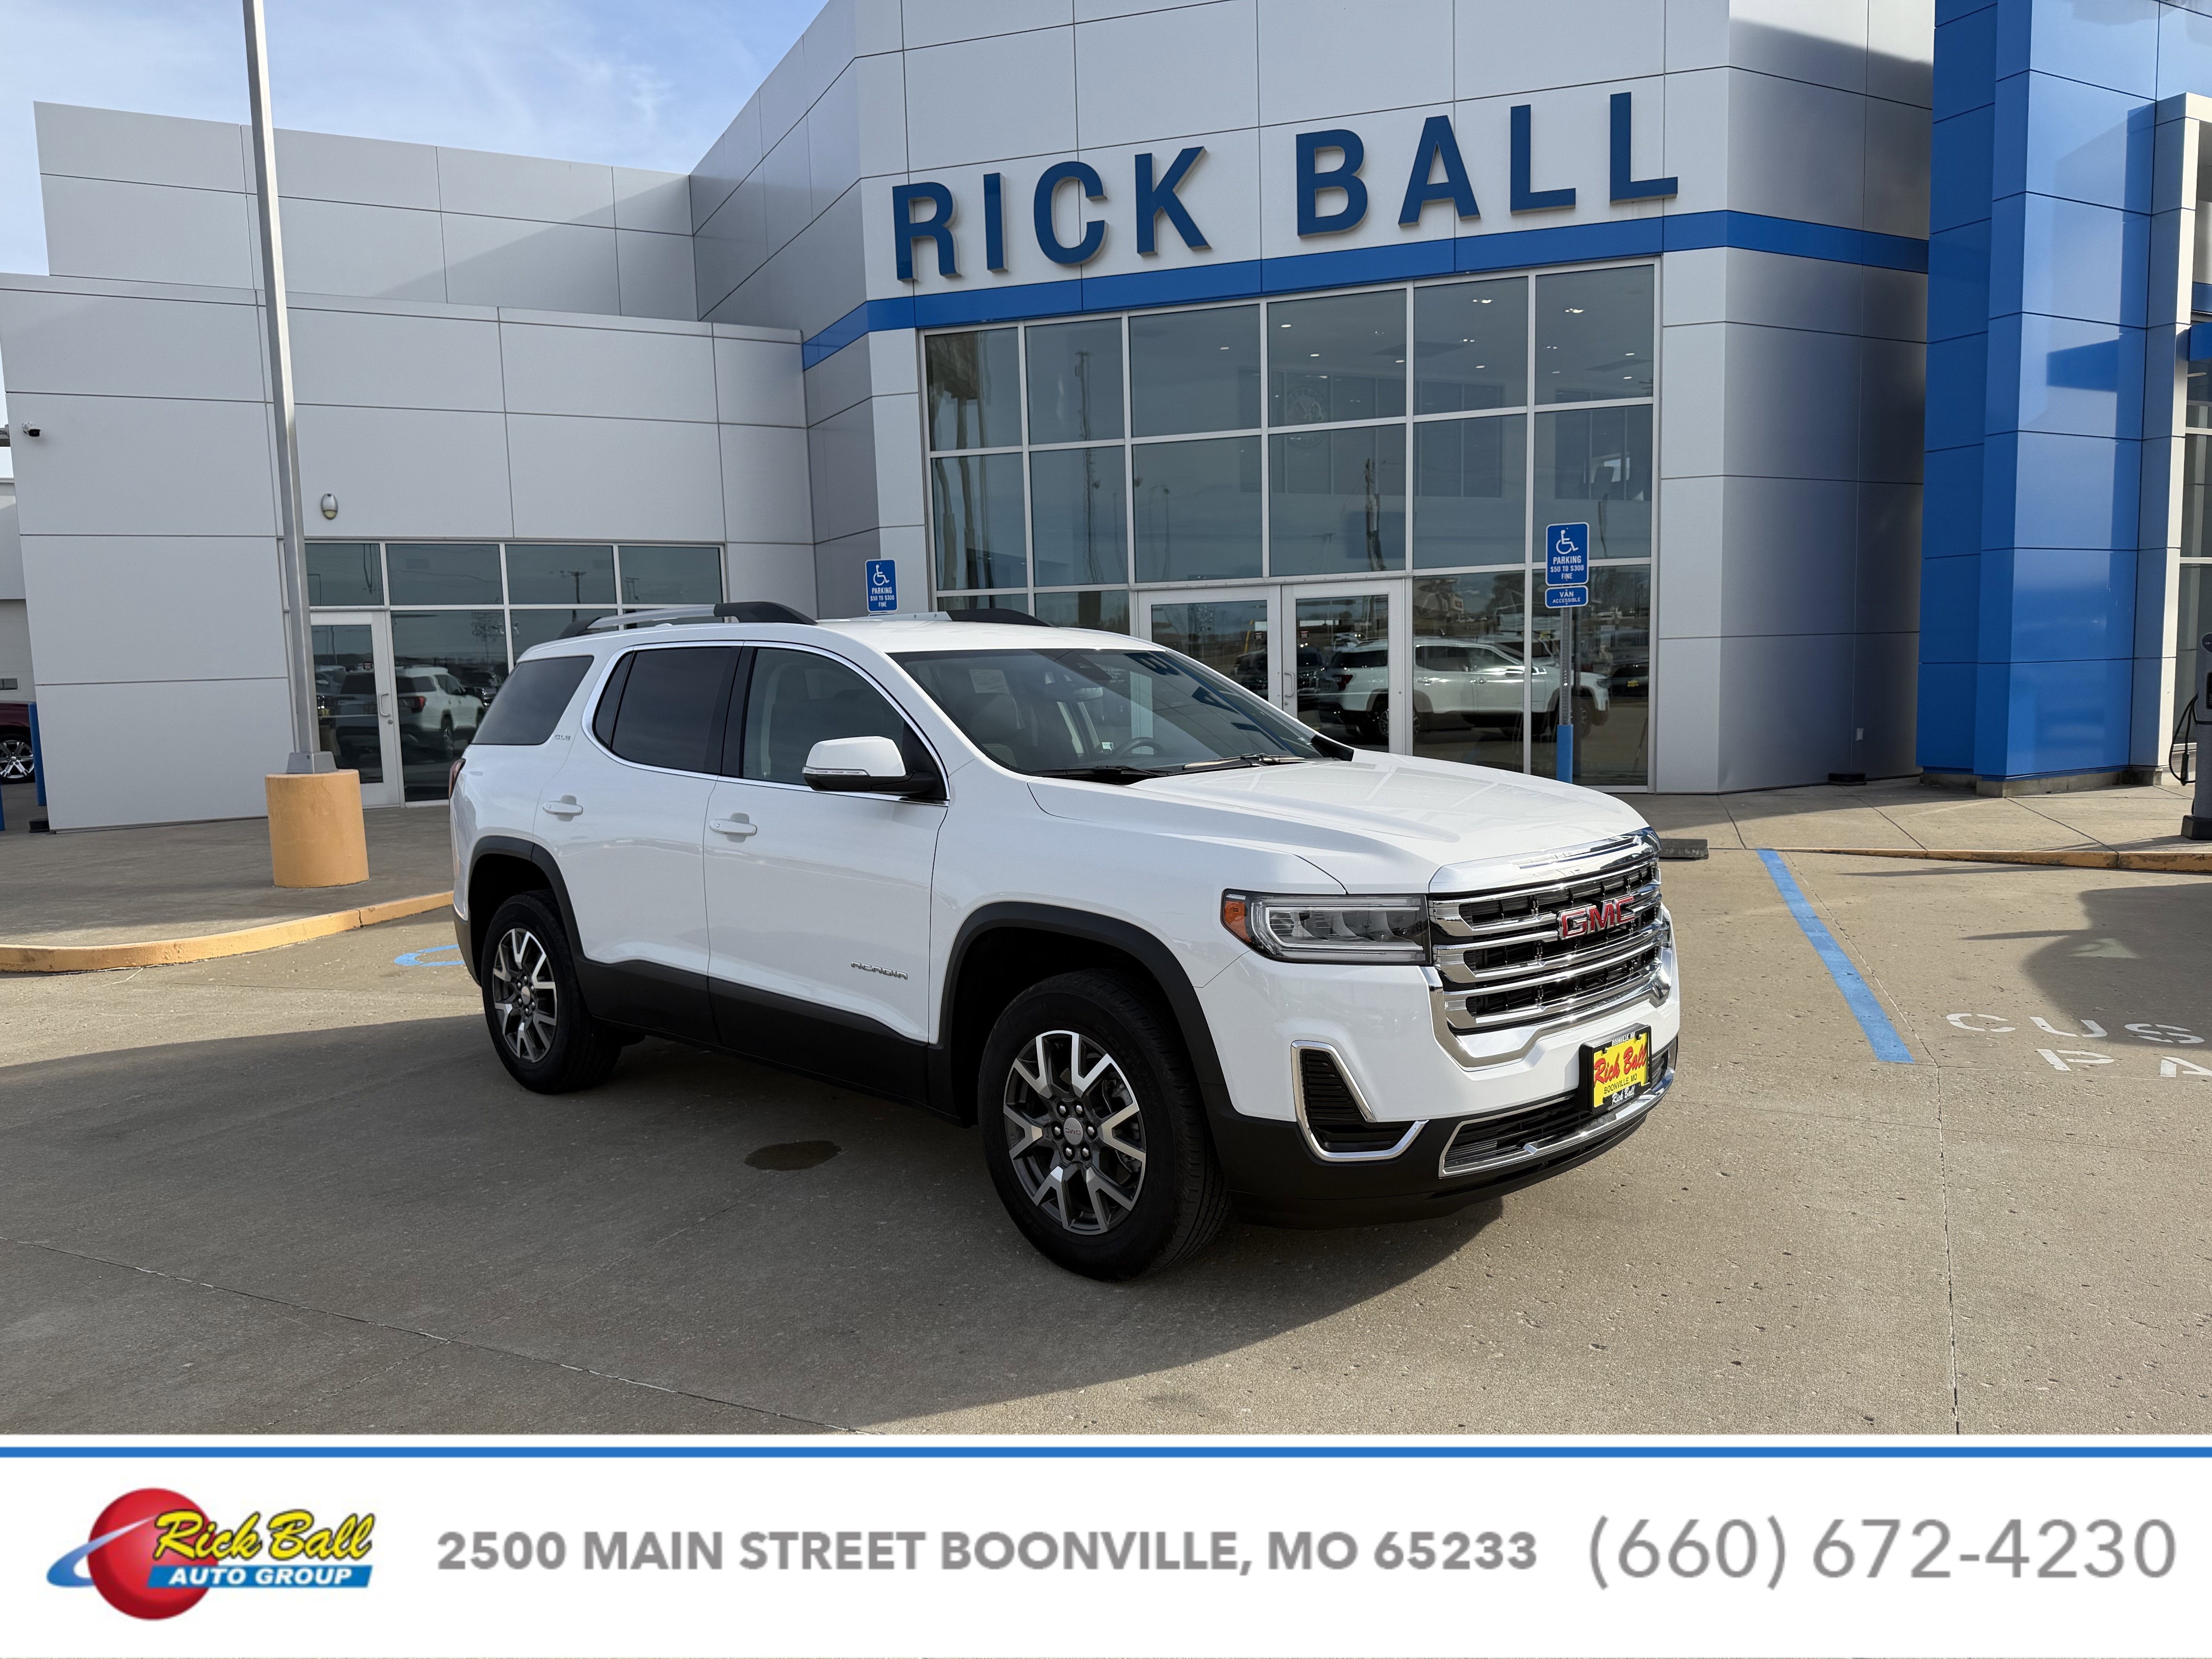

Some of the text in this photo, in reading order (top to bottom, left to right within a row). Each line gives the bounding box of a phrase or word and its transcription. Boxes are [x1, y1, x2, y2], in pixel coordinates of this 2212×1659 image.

[892, 92, 1678, 282] RICK BALL
[1553, 555, 1582, 564] PARKING
[1558, 896, 1635, 939] GMC
[851, 961, 908, 980] ACADIA
[1594, 1043, 1647, 1087] Rick Ball
[1631, 1073, 1637, 1082] MO
[1612, 1085, 1635, 1105] Rick Ball
